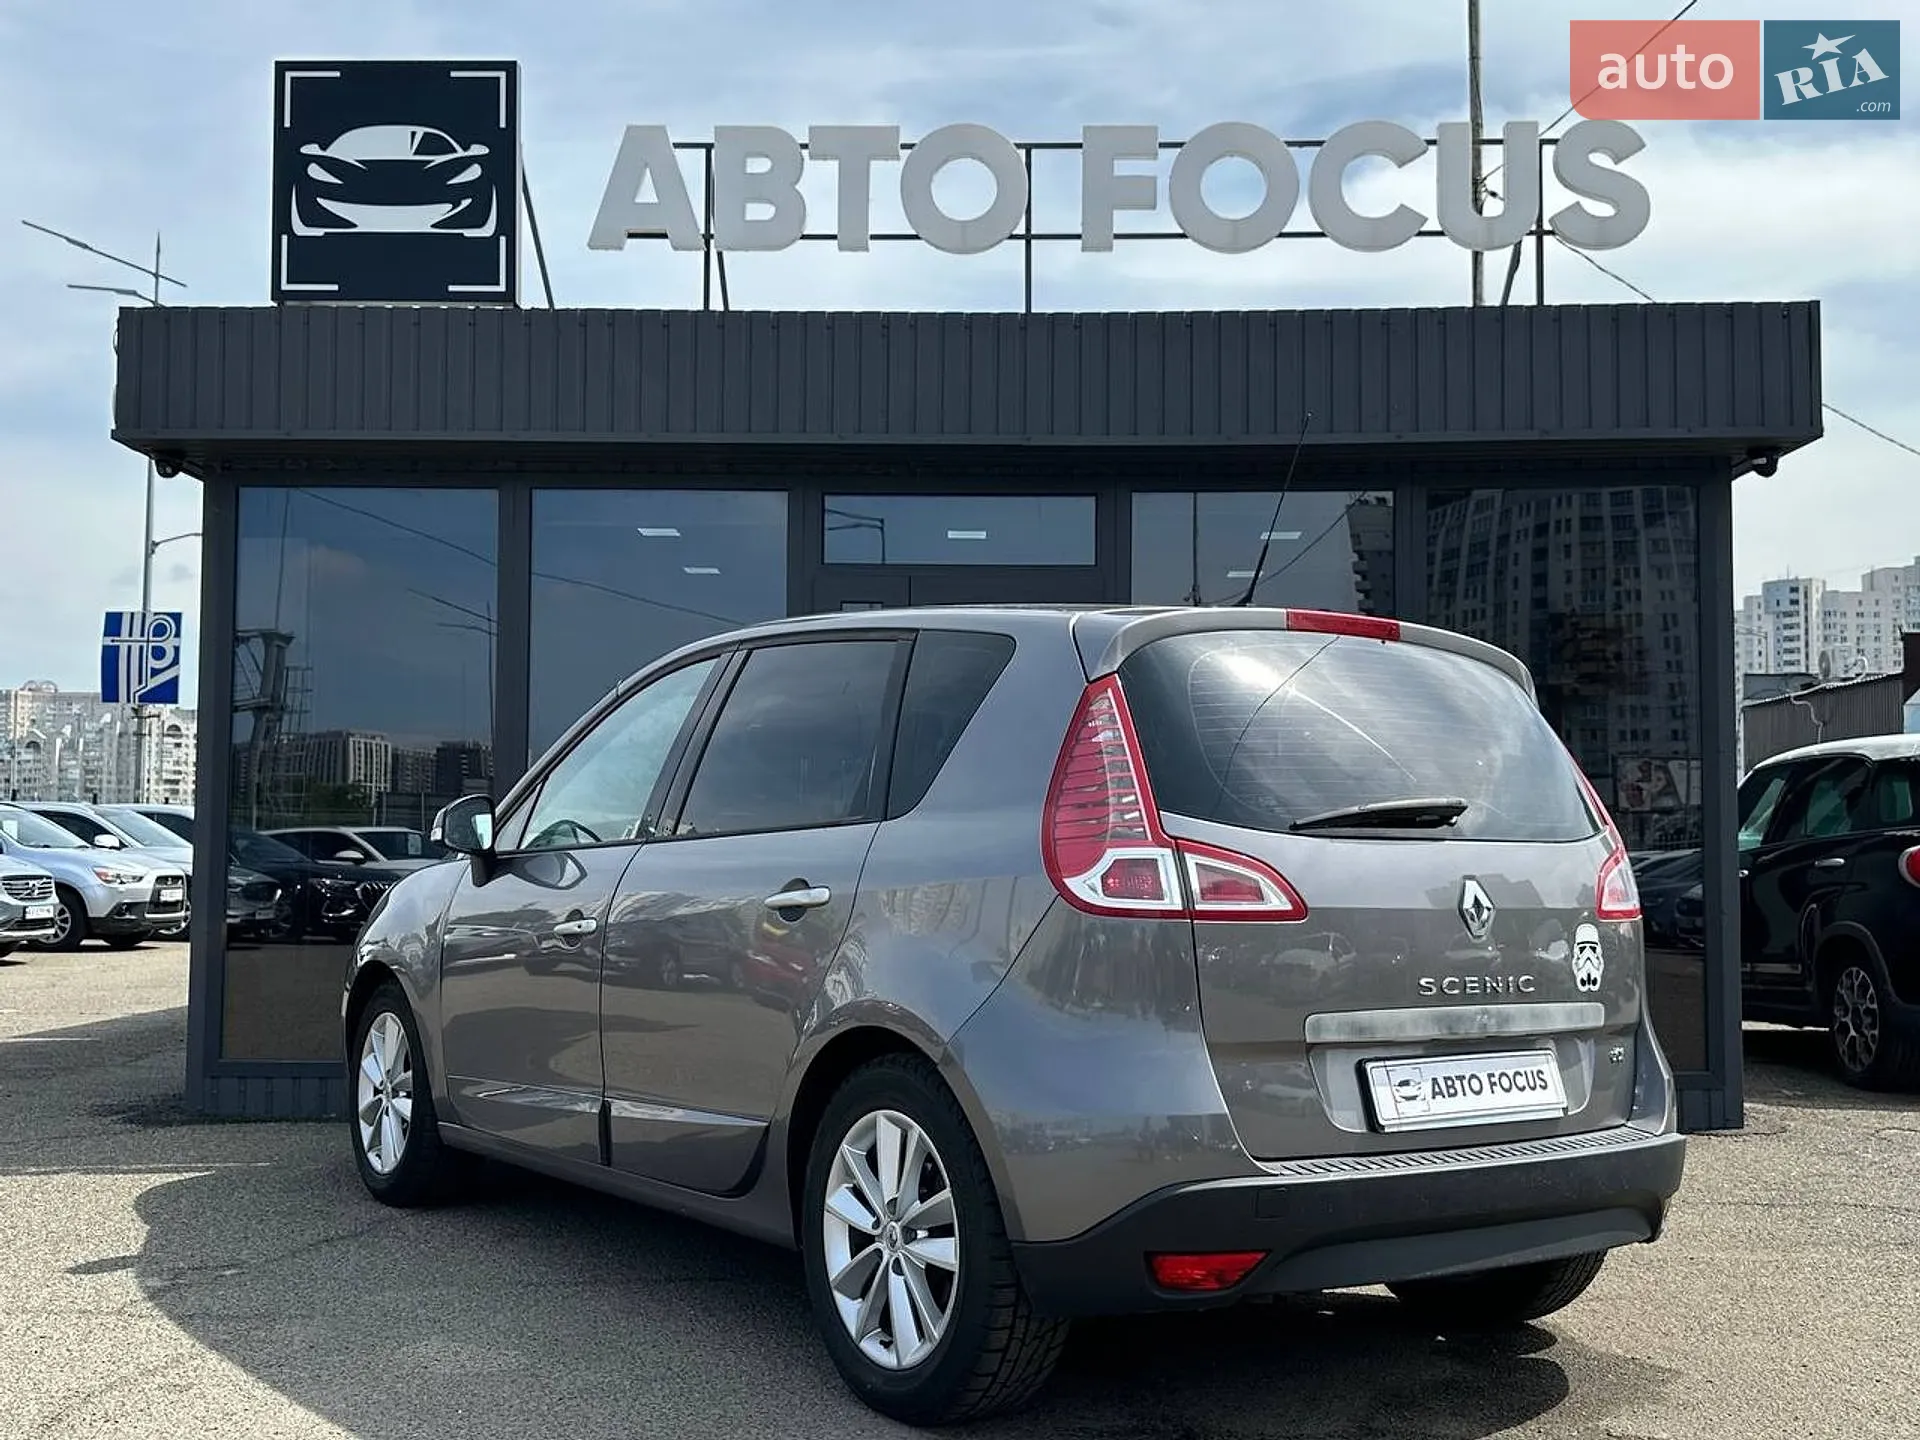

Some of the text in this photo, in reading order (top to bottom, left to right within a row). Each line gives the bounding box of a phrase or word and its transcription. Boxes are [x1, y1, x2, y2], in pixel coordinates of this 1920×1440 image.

[587, 119, 1651, 254] АВТО FOCUS
[1417, 974, 1537, 997] SCENIC
[1430, 1068, 1549, 1100] АВТО FOCUS
